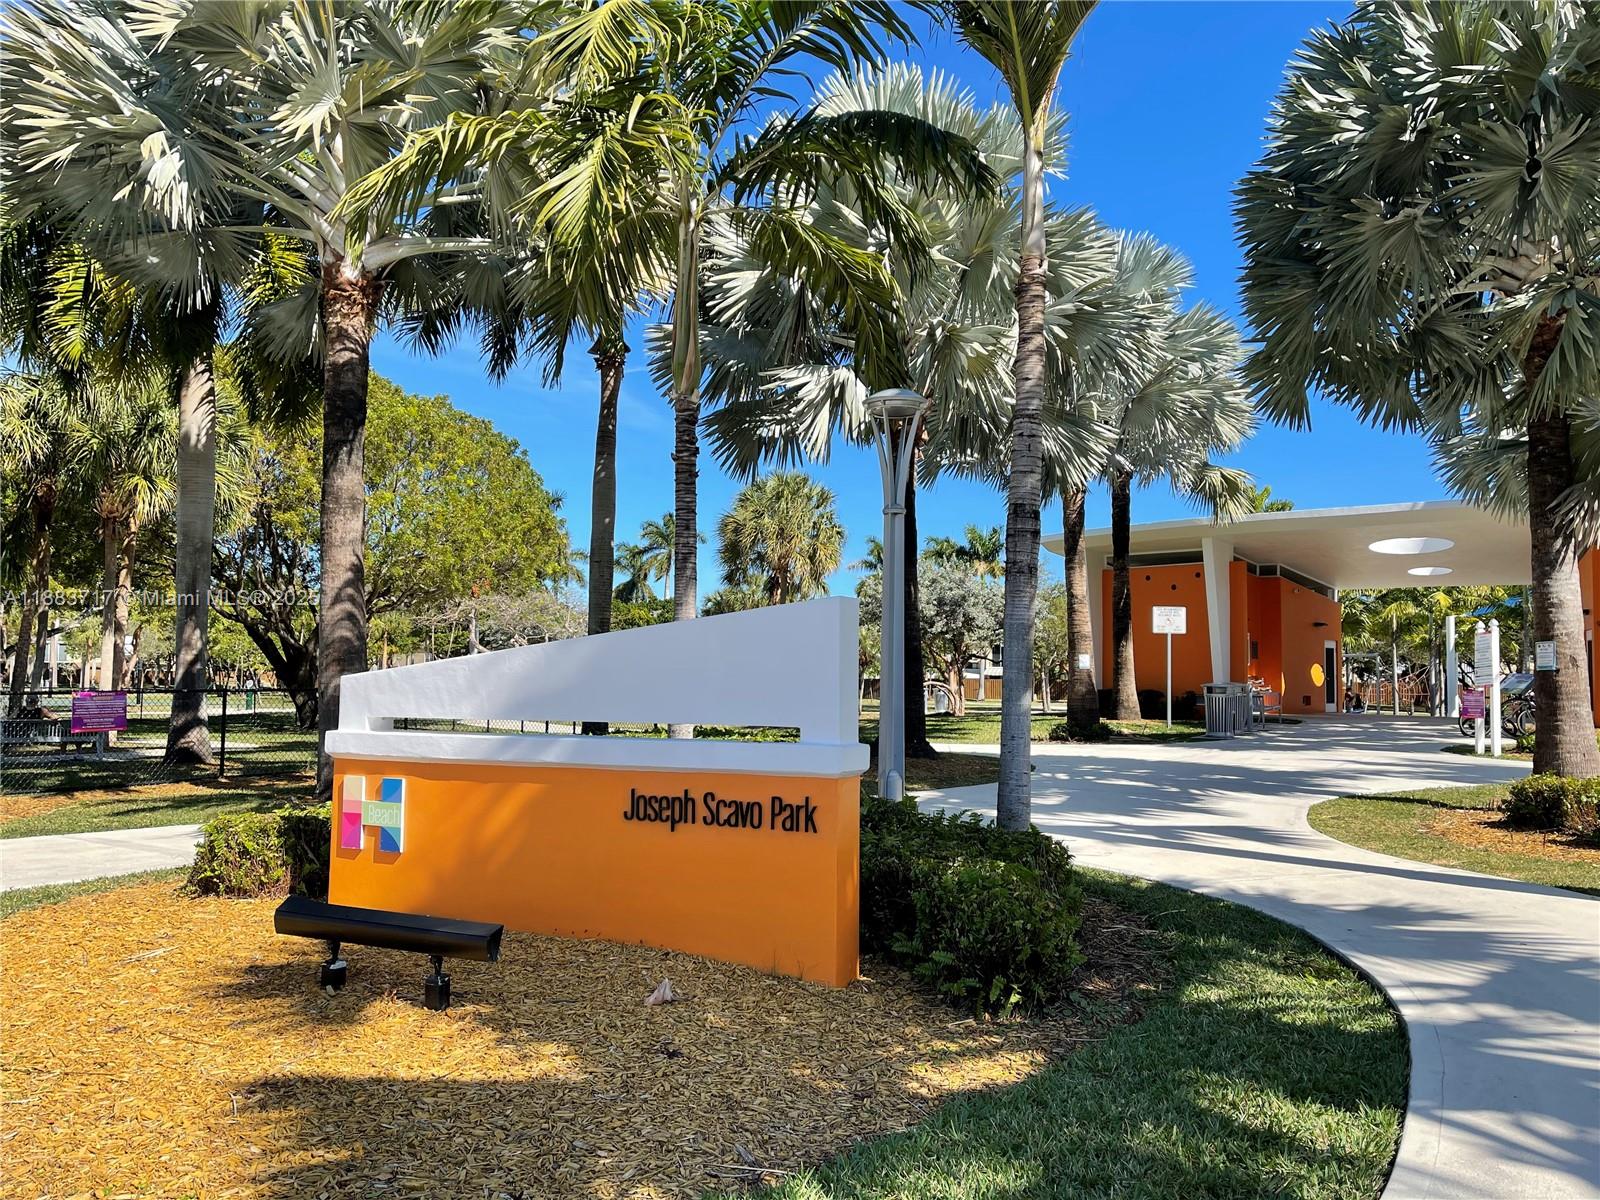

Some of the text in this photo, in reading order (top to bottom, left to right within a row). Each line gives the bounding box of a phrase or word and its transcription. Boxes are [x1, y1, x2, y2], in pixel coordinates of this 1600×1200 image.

[368, 804, 400, 825] Beach
[623, 788, 818, 833] Joseph Scavo Park
